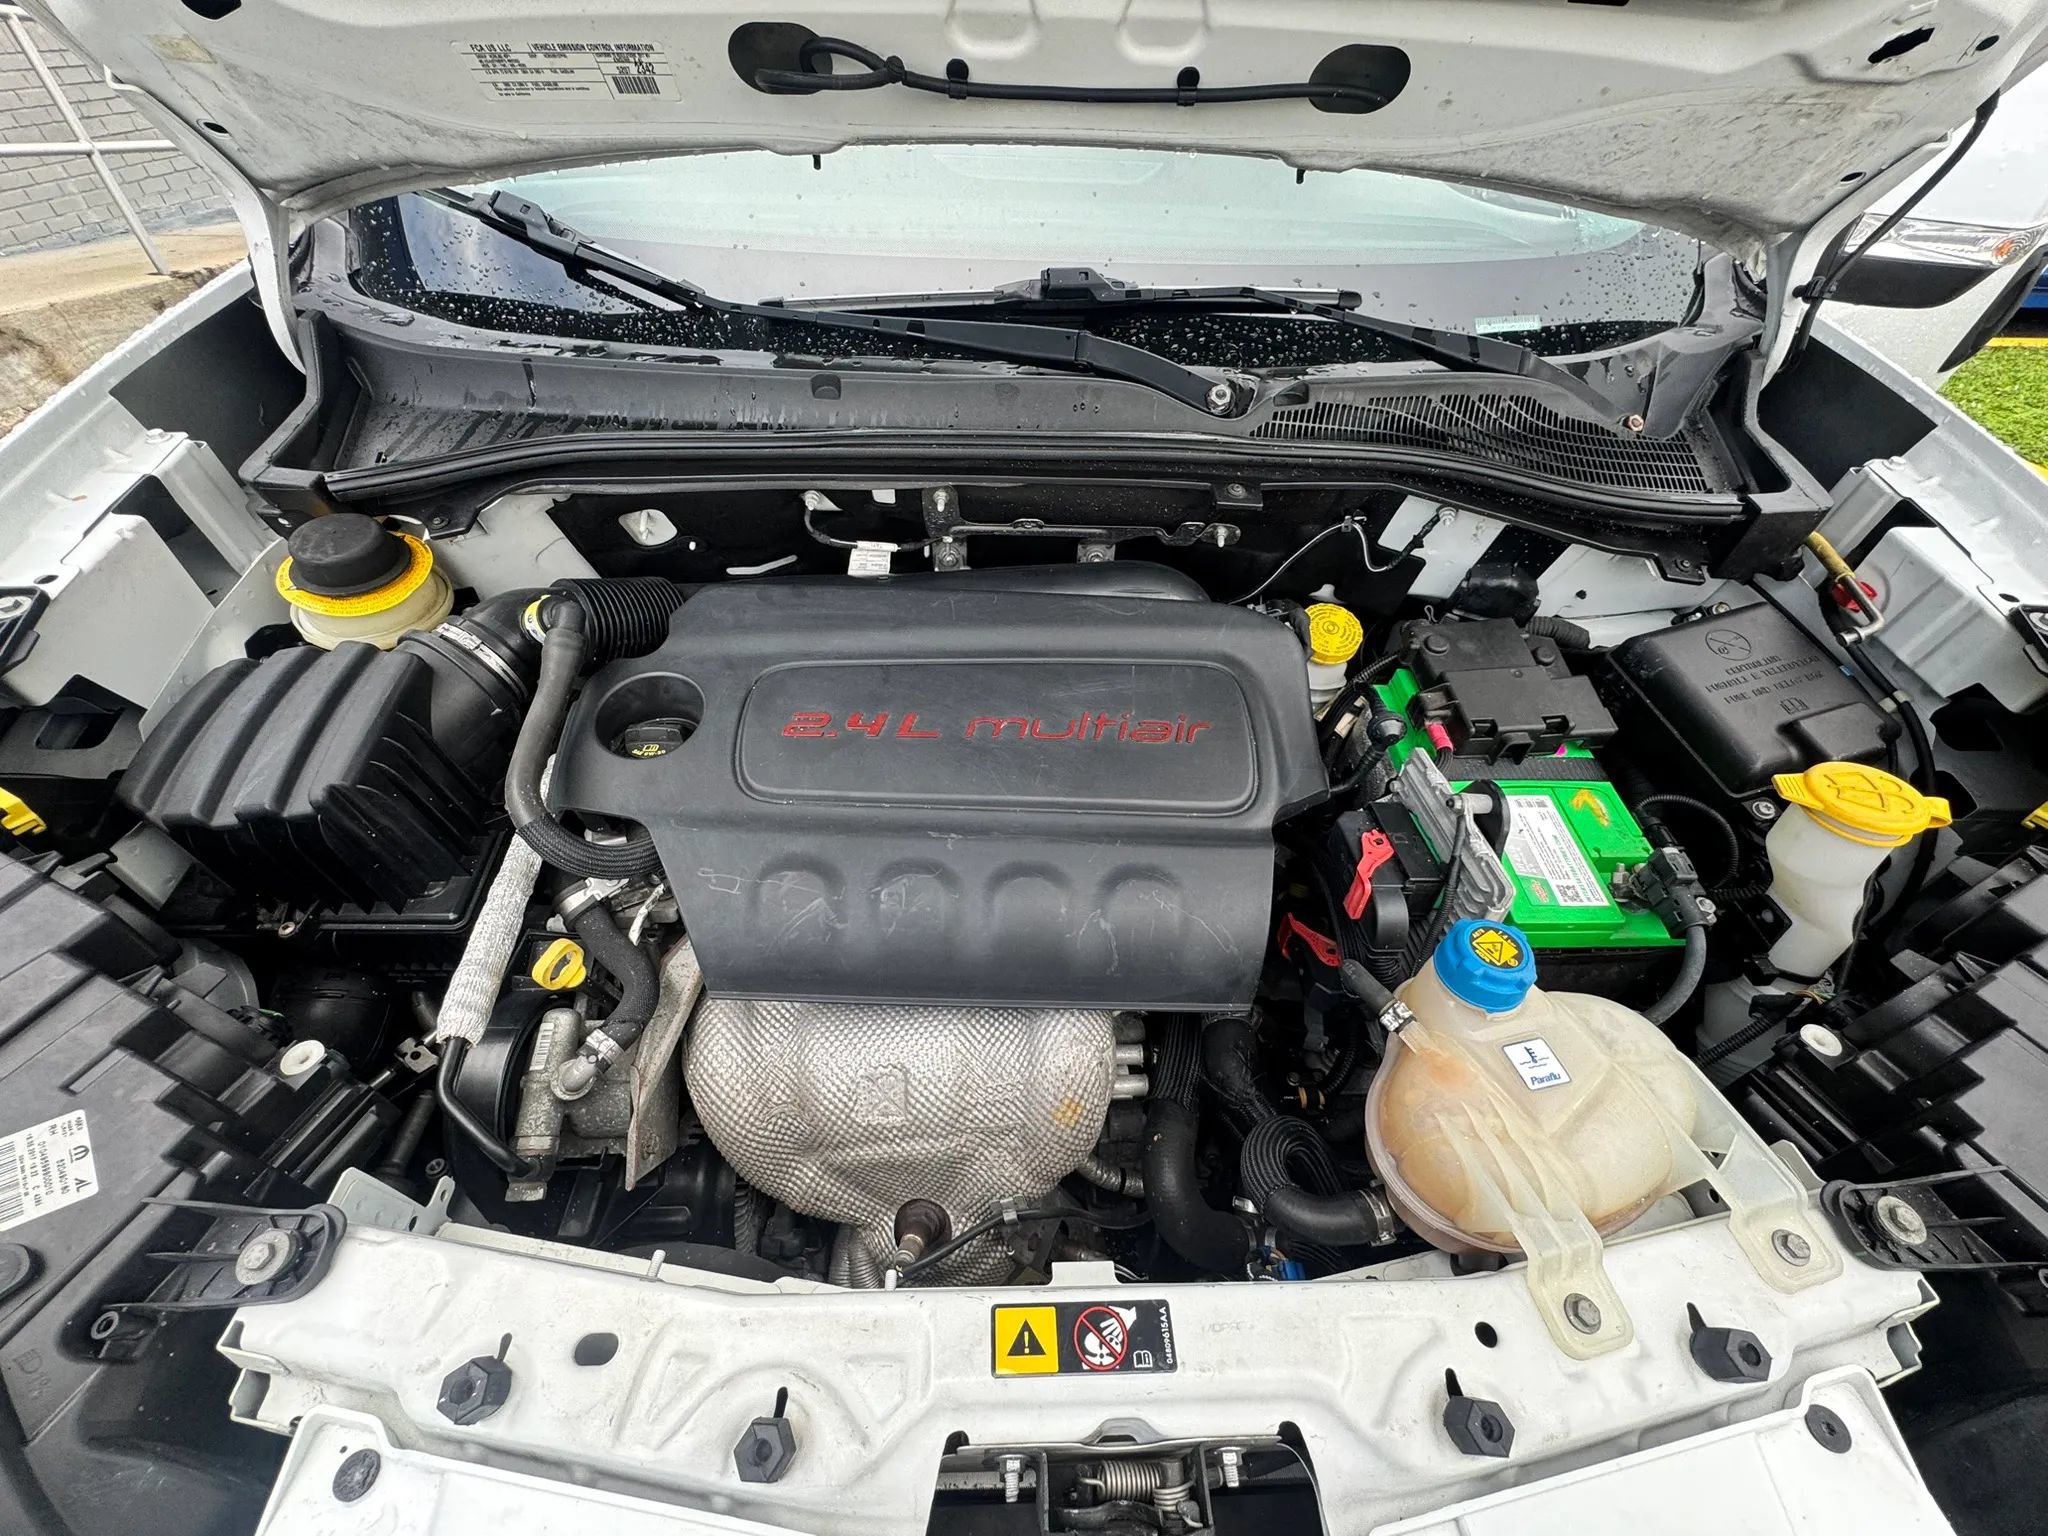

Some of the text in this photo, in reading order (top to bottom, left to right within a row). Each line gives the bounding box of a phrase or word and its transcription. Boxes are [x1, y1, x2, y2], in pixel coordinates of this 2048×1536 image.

[469, 44, 512, 52] FCA US LLC
[531, 43, 655, 52] VEHICLE EMISSION CONTROL INFORMATION
[964, 710, 1213, 744] multiair
[1530, 1071, 1562, 1086] Paraflu
